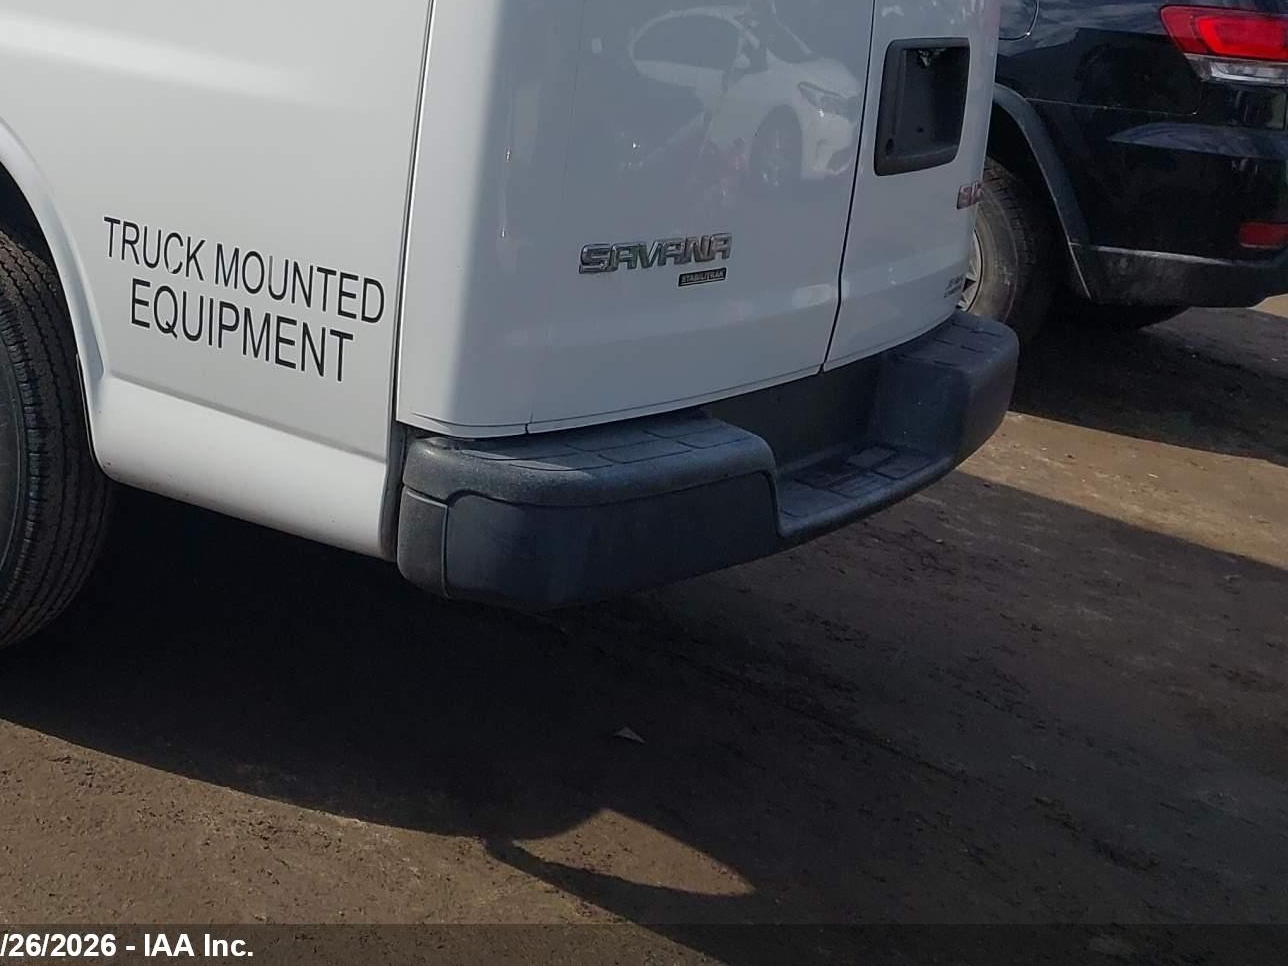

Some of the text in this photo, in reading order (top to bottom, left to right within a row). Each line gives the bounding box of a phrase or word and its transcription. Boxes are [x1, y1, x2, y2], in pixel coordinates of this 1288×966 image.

[103, 216, 385, 324] TRUCK MOUNTED
[578, 233, 732, 274] SAVANA
[130, 277, 354, 383] EQUIPMENT
